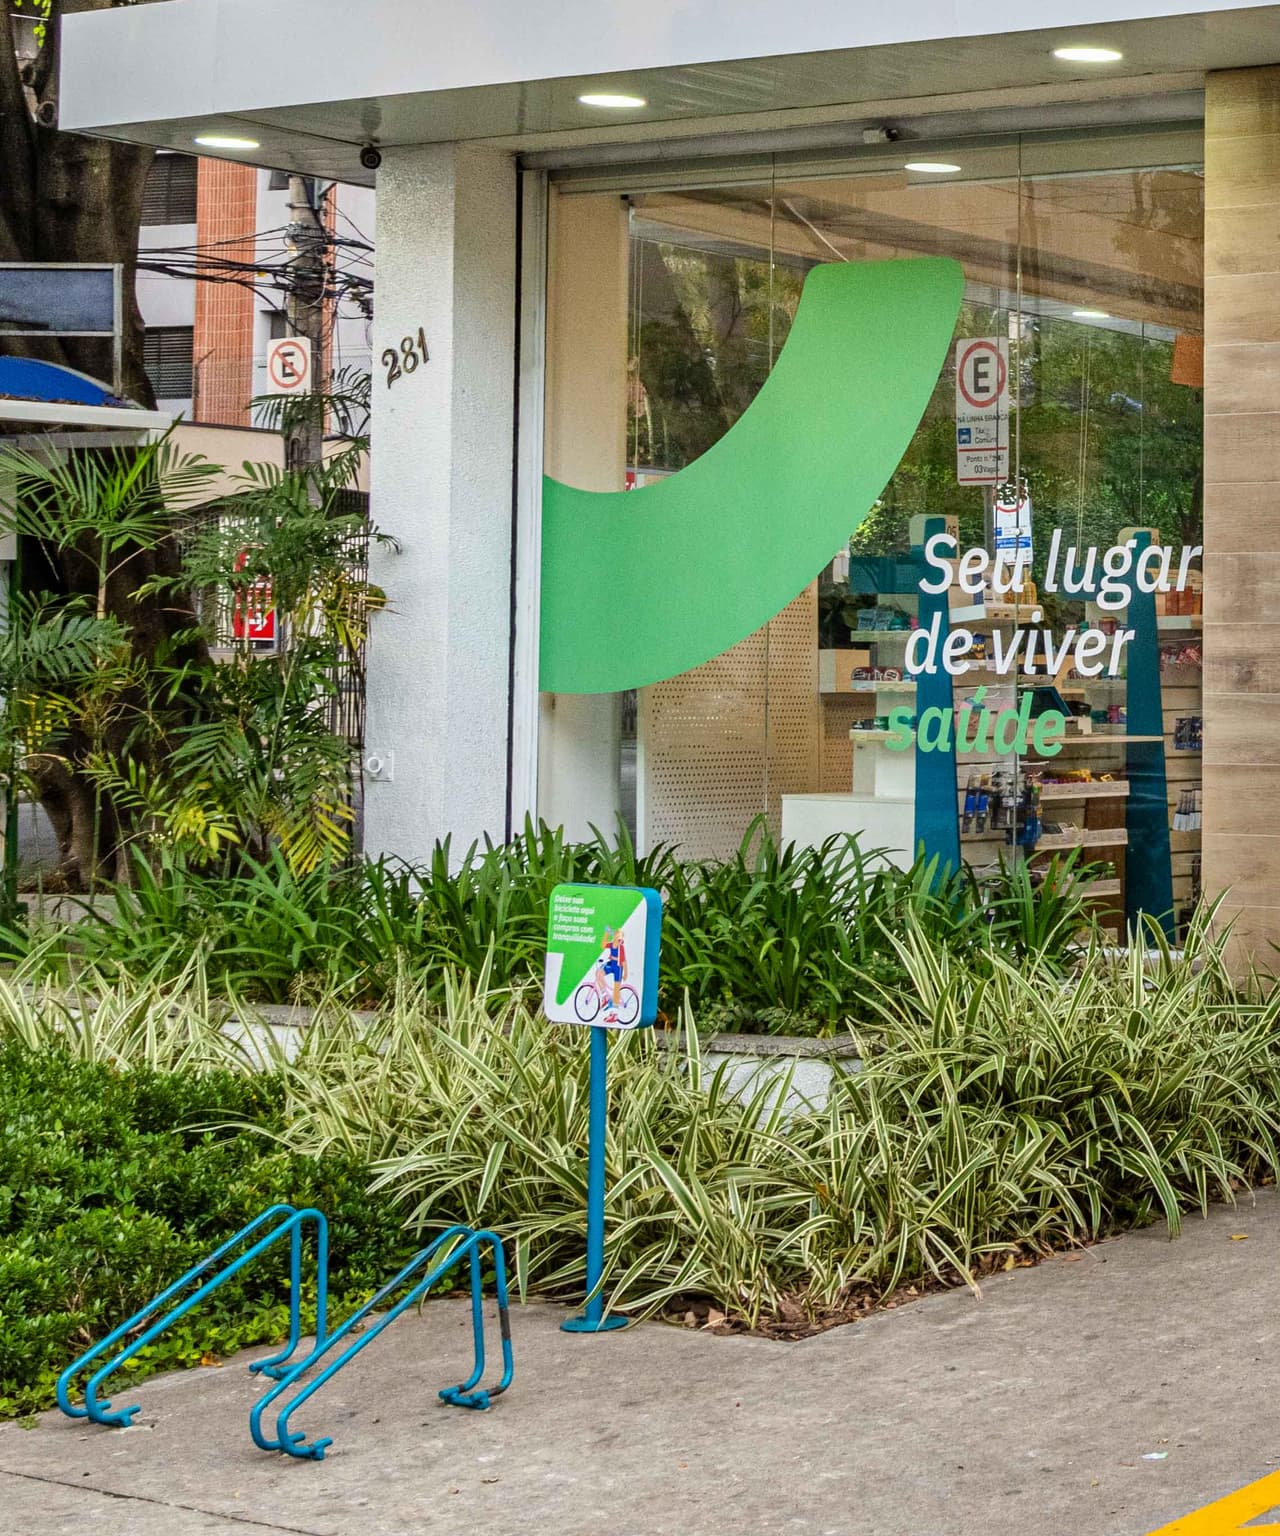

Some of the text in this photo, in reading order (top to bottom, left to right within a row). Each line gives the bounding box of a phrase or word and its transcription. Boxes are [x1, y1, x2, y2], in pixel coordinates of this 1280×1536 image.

[382, 327, 430, 389] 281
[973, 356, 990, 394] E
[918, 528, 1204, 611] Seu lugar
[904, 611, 1135, 677] de viver
[884, 685, 1067, 758] saúde
